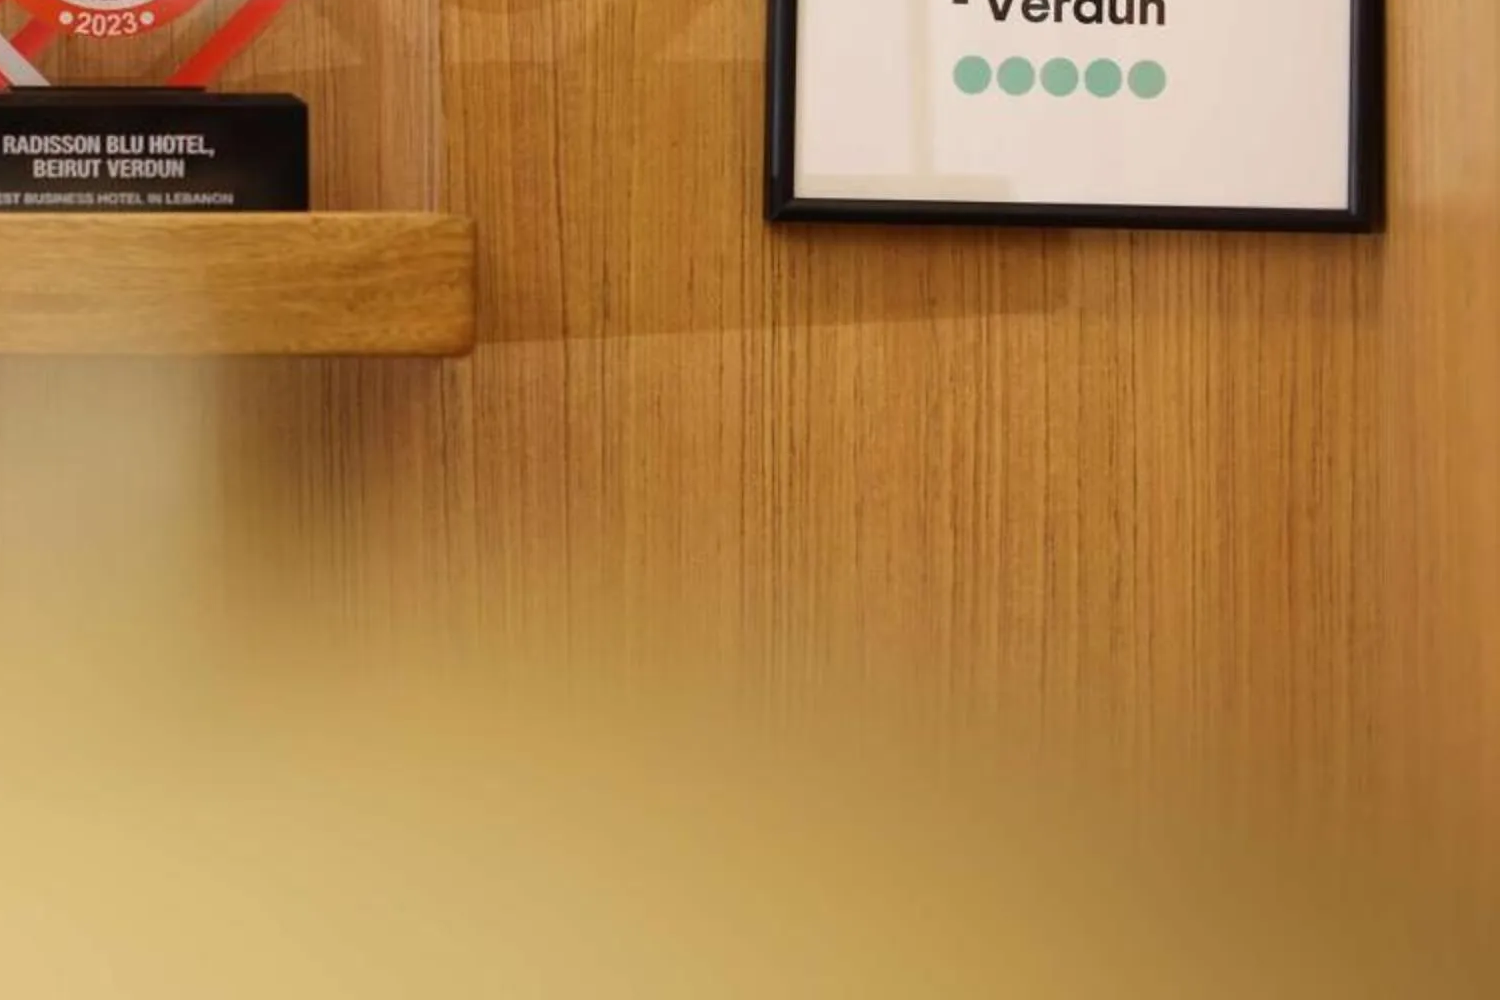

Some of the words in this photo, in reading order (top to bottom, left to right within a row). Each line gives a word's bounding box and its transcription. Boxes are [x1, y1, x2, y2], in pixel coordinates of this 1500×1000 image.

[74, 12, 138, 36] 2023
[2, 135, 100, 155] RADISSON
[106, 135, 144, 155] BLU
[150, 135, 215, 157] HOTEL,
[33, 159, 102, 179] BEIRUT
[107, 159, 185, 178] VERDUN
[23, 192, 94, 205] BUSINESS
[97, 192, 142, 205] HOTEL
[147, 192, 162, 205] IN
[165, 192, 234, 205] LEBANON
